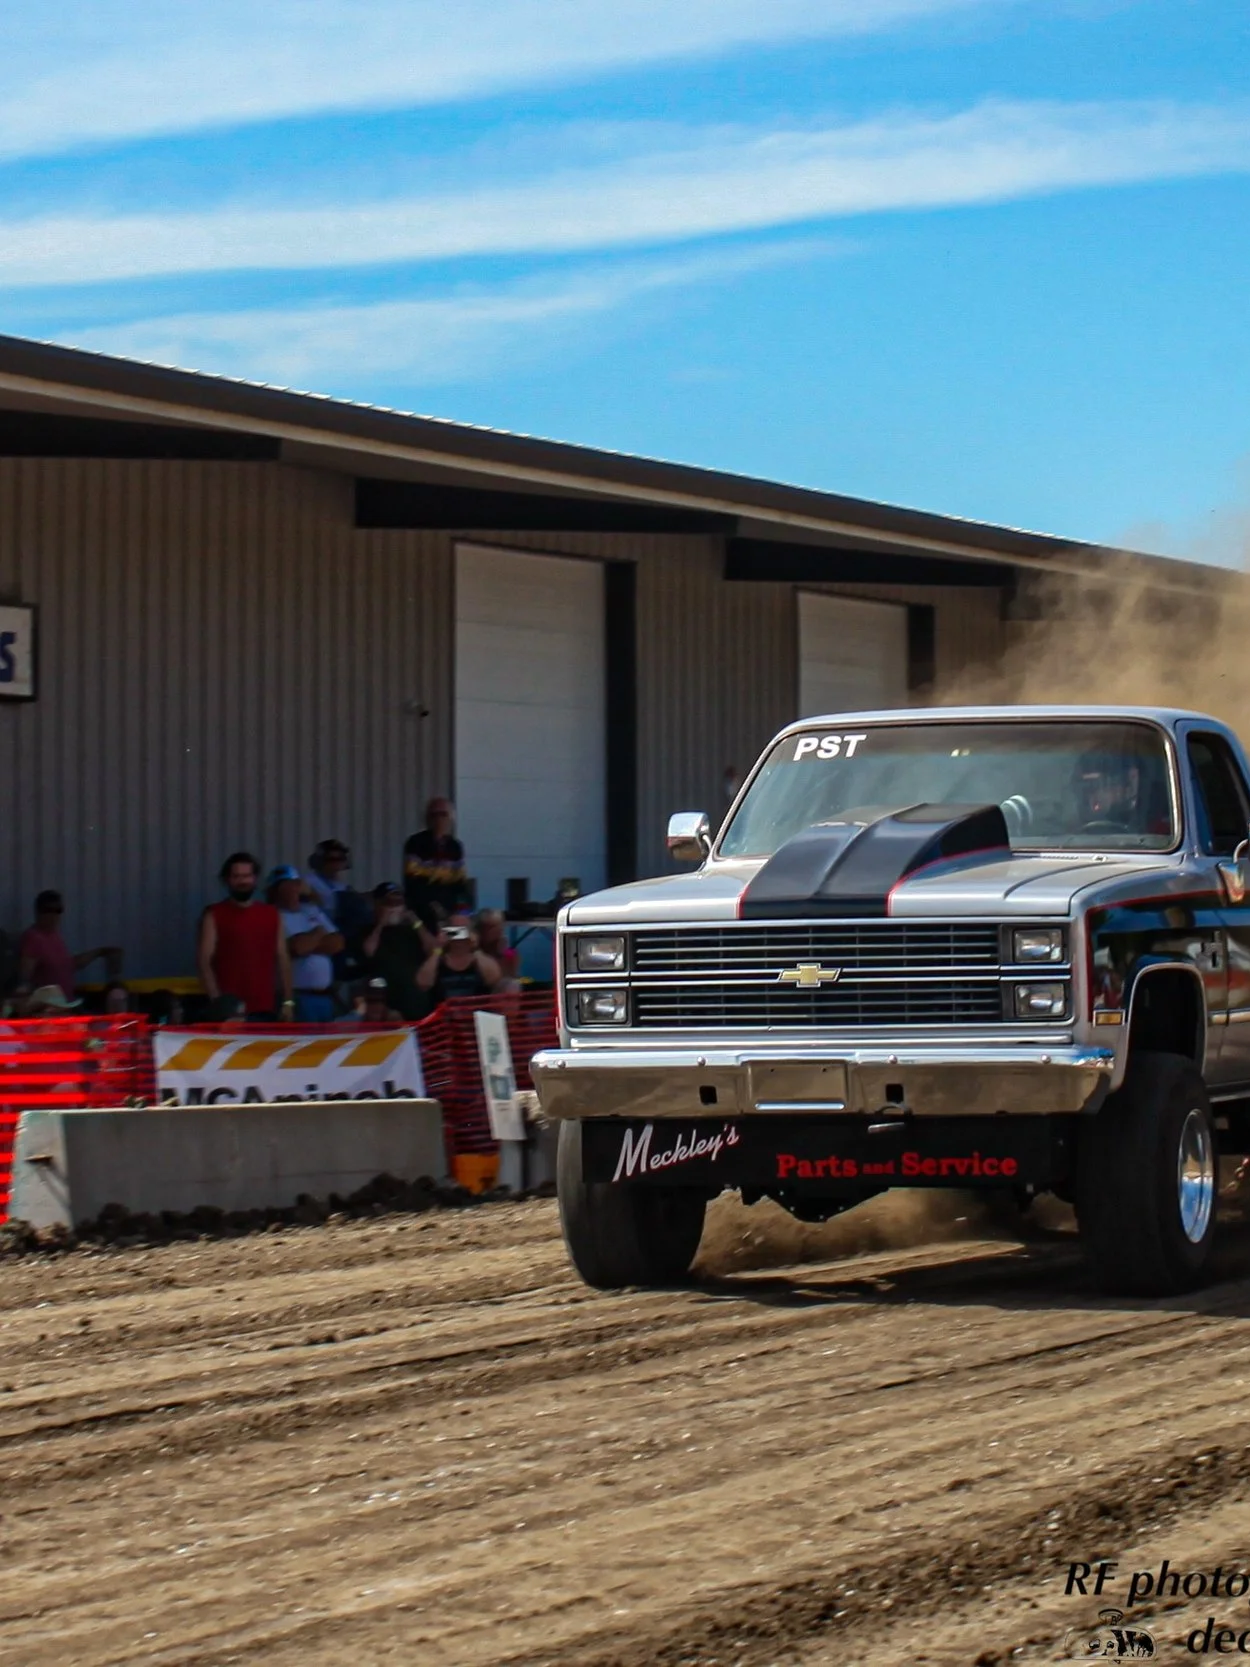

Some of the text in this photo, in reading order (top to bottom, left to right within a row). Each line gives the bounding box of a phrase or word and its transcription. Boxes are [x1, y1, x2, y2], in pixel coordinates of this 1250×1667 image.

[793, 734, 867, 761] PST
[612, 1124, 739, 1182] Meckley's
[776, 1152, 1018, 1178] Parts and Service
